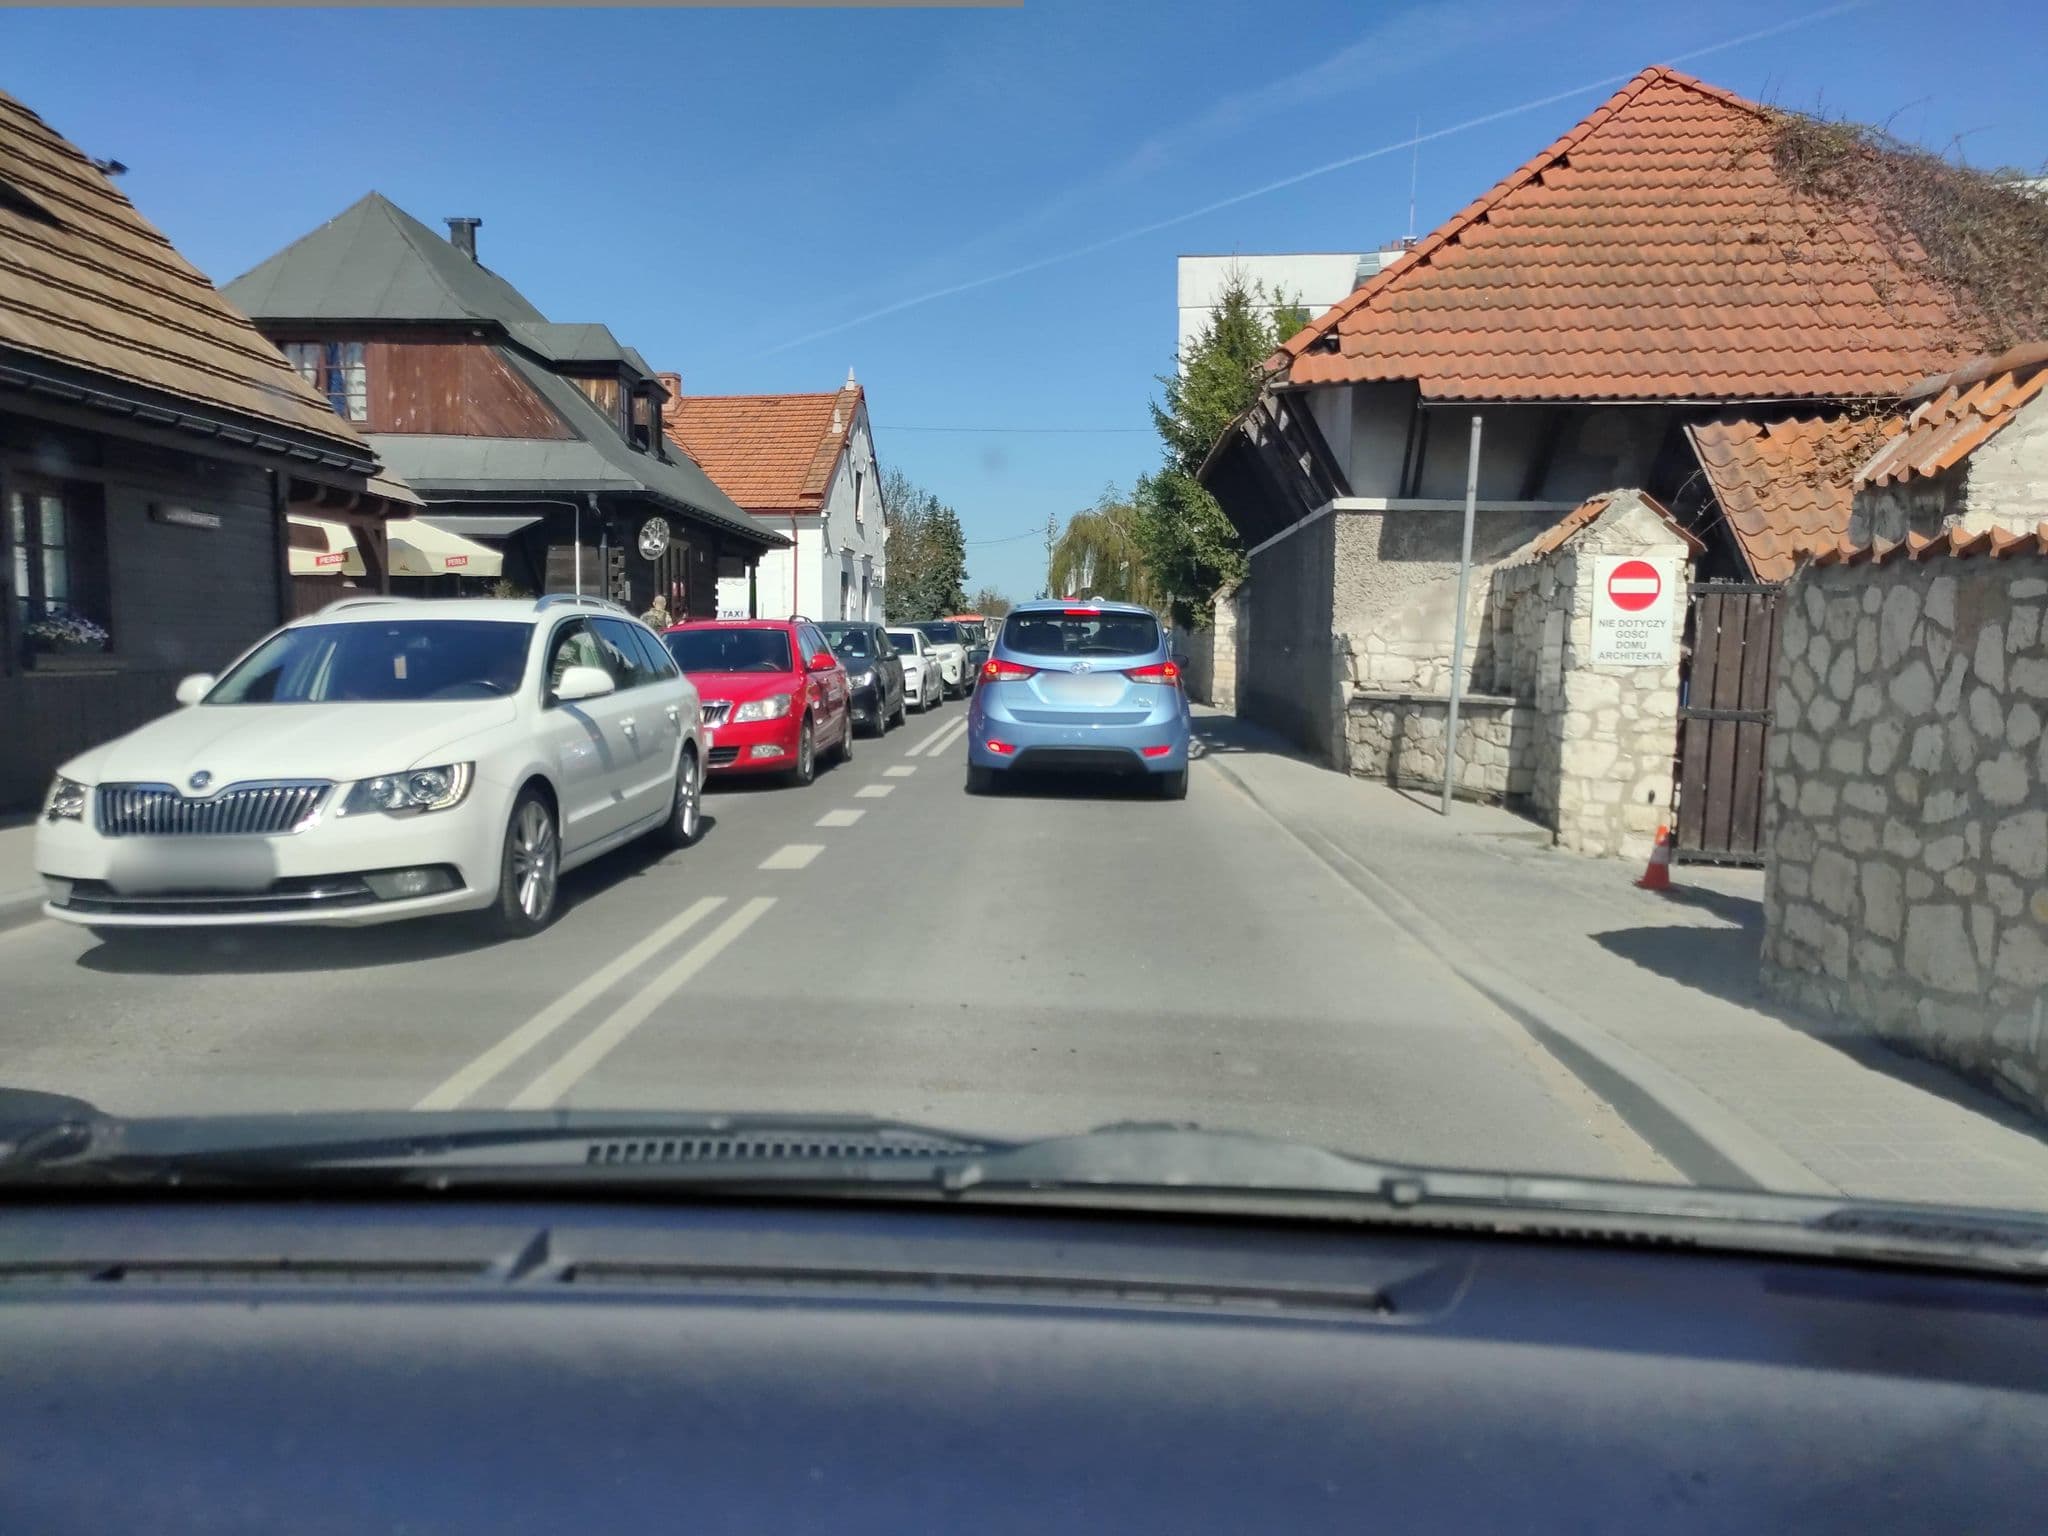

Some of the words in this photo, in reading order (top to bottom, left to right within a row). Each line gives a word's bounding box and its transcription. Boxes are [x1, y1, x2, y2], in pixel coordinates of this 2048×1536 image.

[722, 610, 744, 618] TAXI
[1599, 619, 1616, 628] NIE
[1618, 619, 1666, 628] DOTYCZY
[1615, 641, 1647, 649] DOMU
[1598, 651, 1663, 660] ARCHITEKTA
